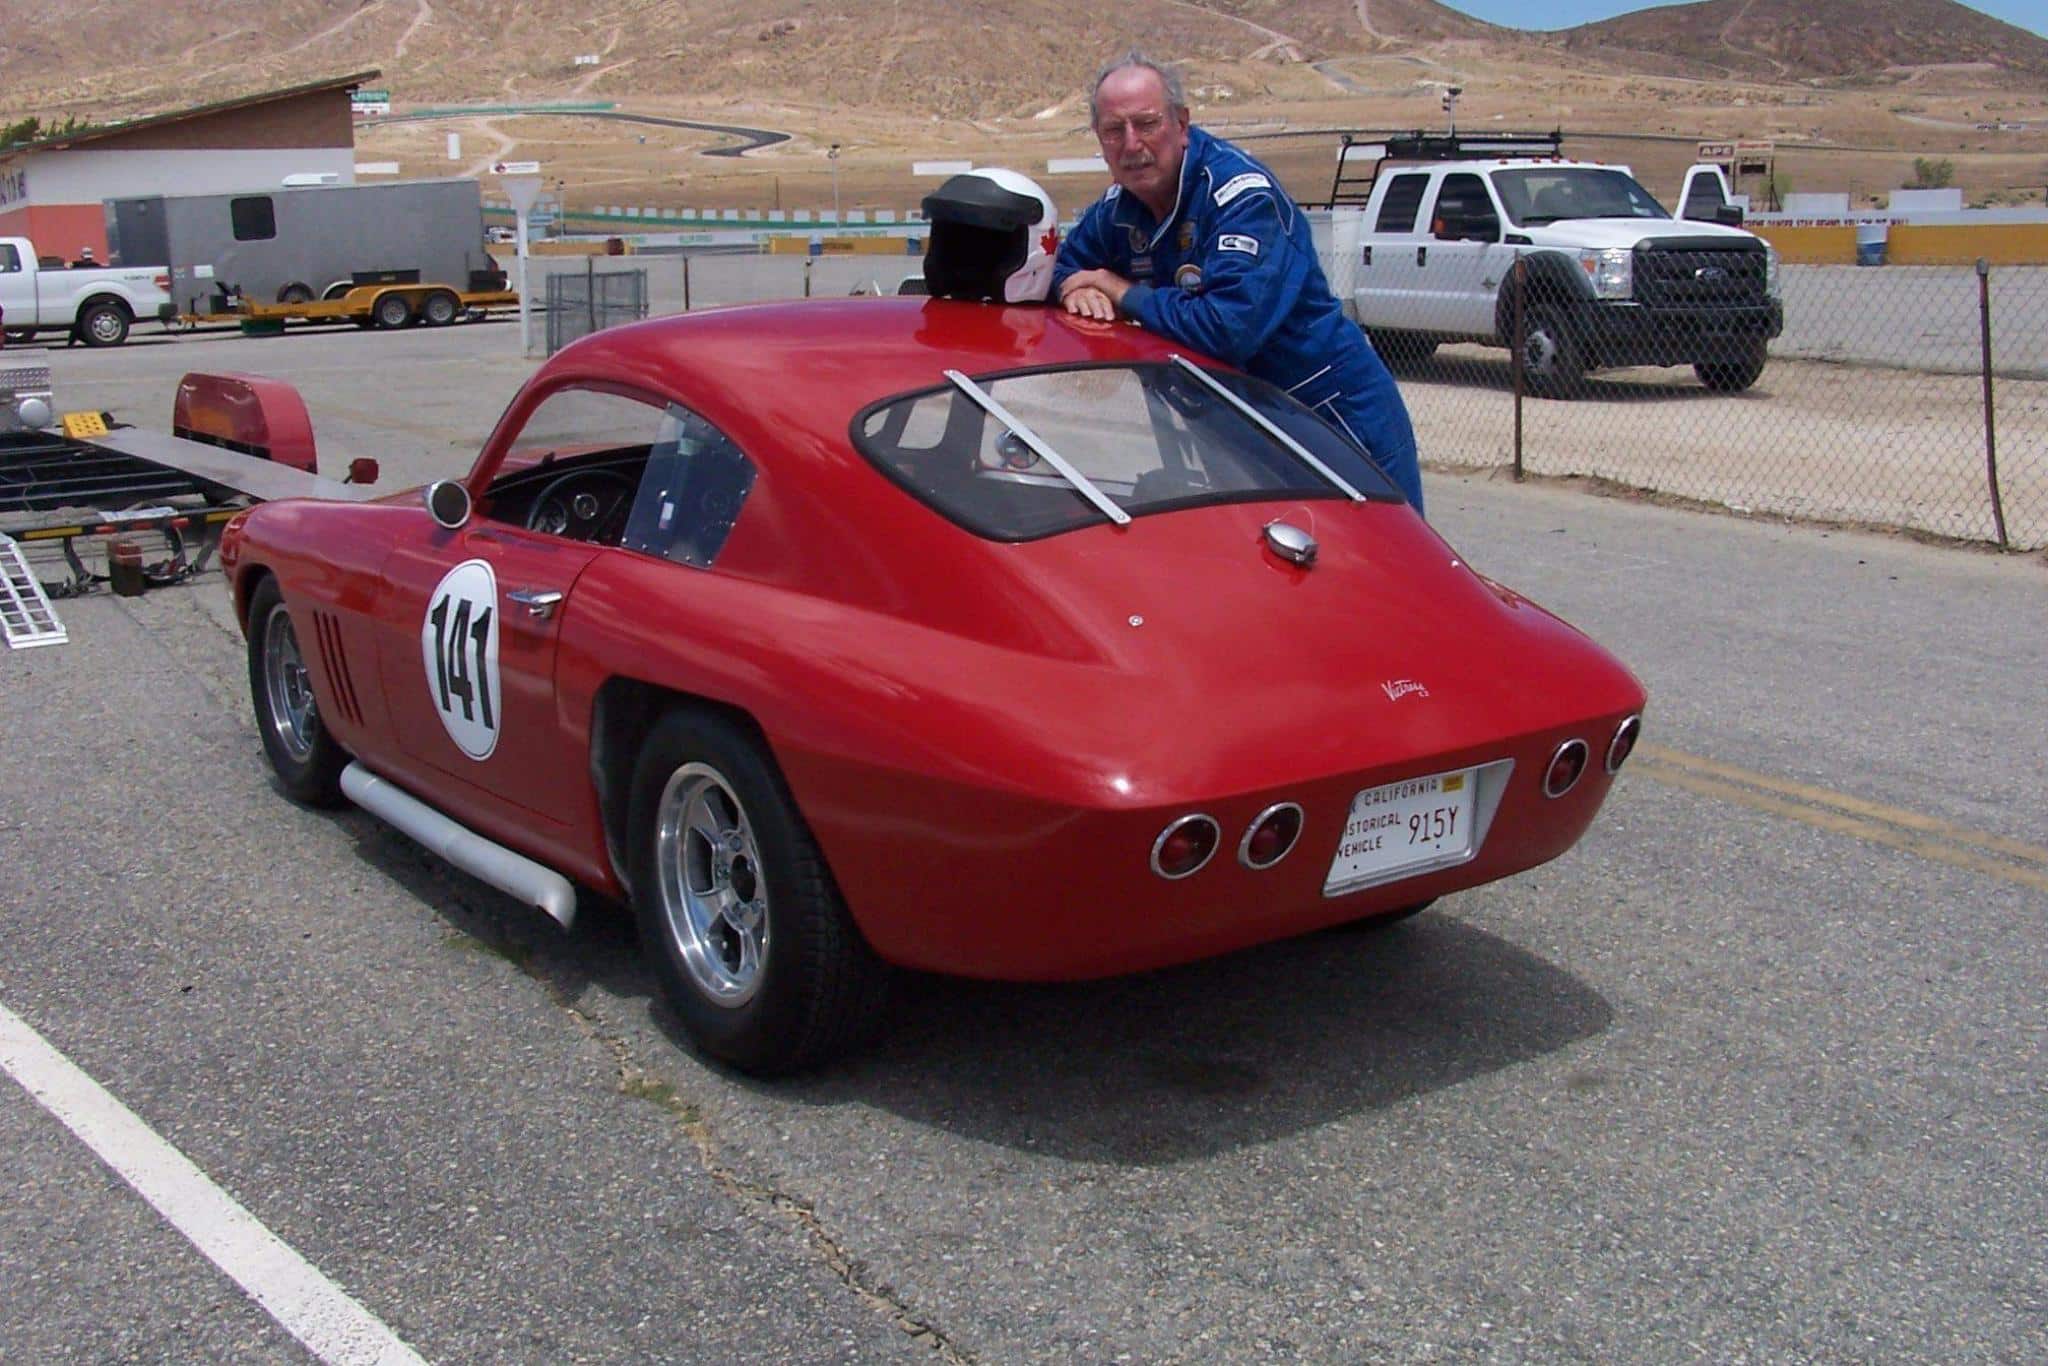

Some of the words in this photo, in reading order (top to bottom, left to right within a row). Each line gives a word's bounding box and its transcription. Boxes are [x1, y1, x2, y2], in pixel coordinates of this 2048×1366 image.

[431, 593, 495, 730] 141
[1364, 778, 1438, 807] CALIFORNIA
[1344, 813, 1401, 837] ISTORICAL
[1408, 804, 1460, 846] 915Y
